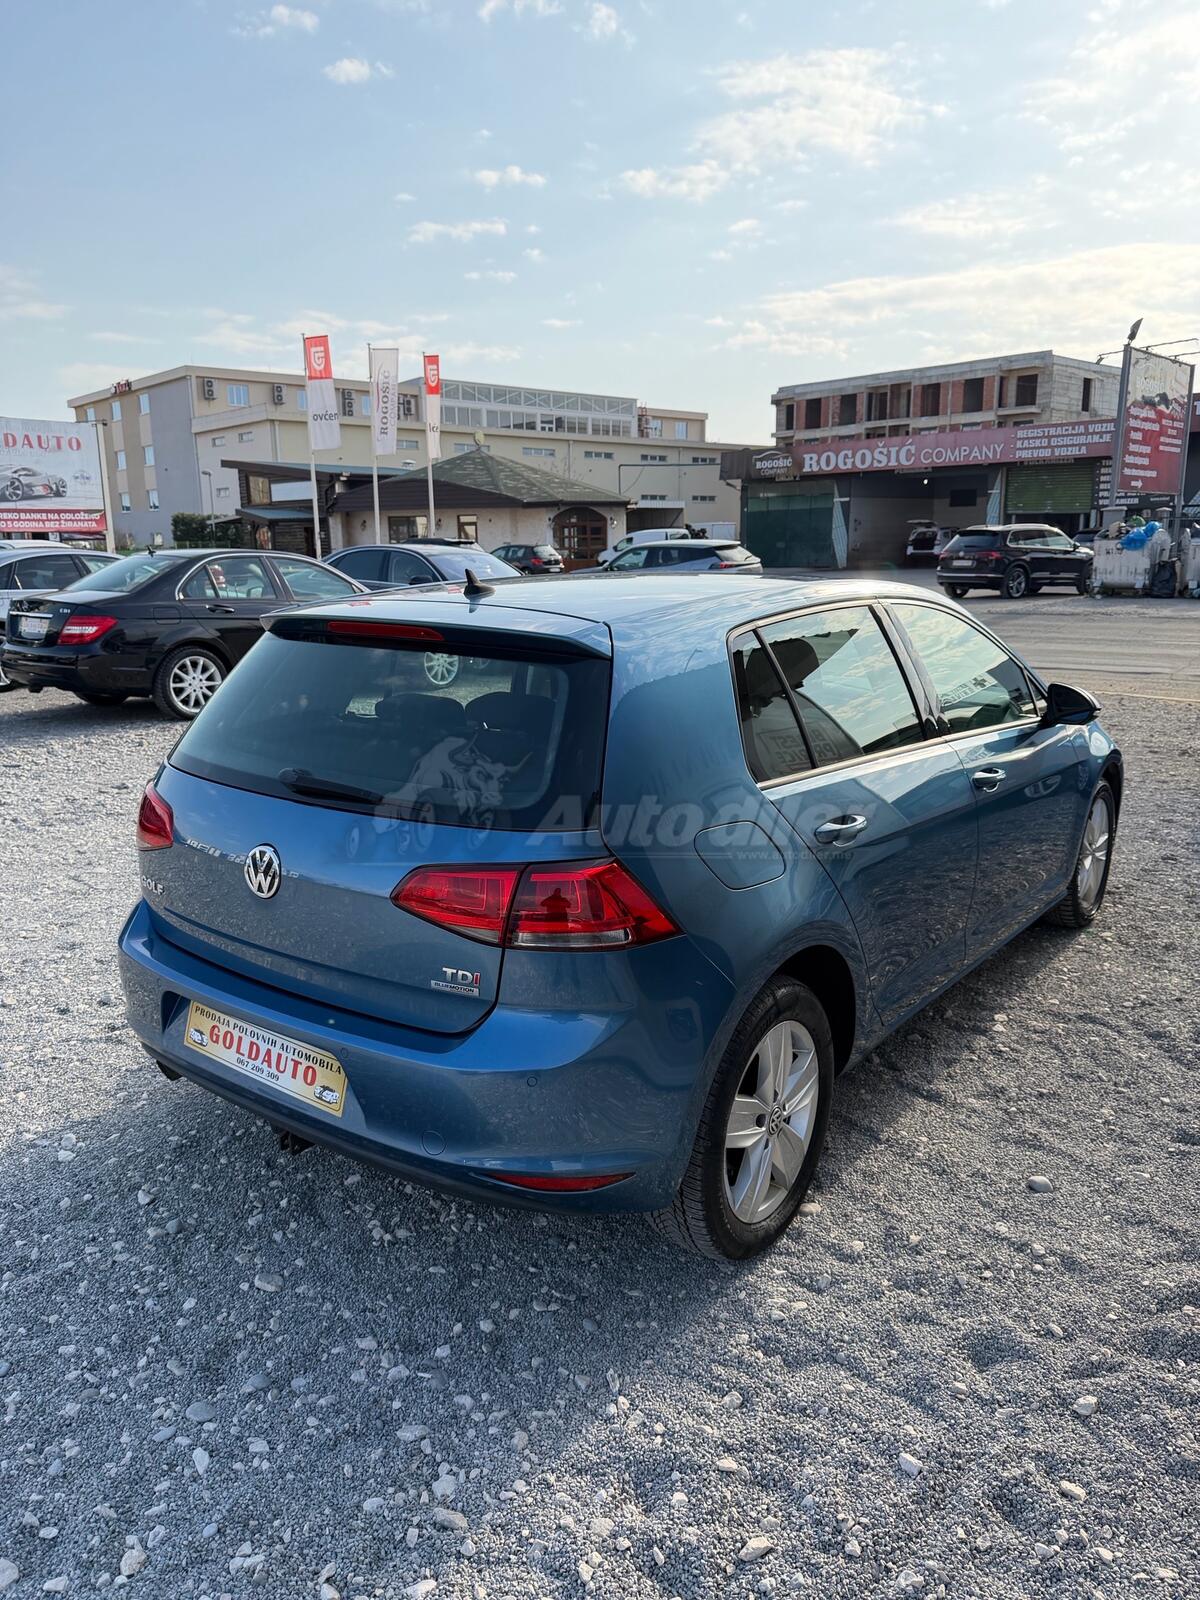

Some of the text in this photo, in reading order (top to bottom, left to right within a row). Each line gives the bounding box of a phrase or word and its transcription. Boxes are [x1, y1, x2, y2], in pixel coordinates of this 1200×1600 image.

[1016, 424, 1085, 439] REGISTRACIJA
[1016, 433, 1112, 448] KASKO OSIGURANJE
[802, 439, 1005, 473] ROGOŠIĆ COMPANY
[1015, 445, 1087, 459] PREVOD VOZILA
[755, 457, 793, 469] ROGOŠIĆ
[19, 512, 48, 520] BANKE
[48, 512, 60, 520] NA
[140, 874, 165, 896] GOLF
[442, 966, 481, 987] TDI
[194, 1004, 343, 1076] PRODAJA POLOVNIH AUTOMOBILA
[209, 1024, 318, 1087] GOLDAUTO
[236, 1056, 250, 1070] 067
